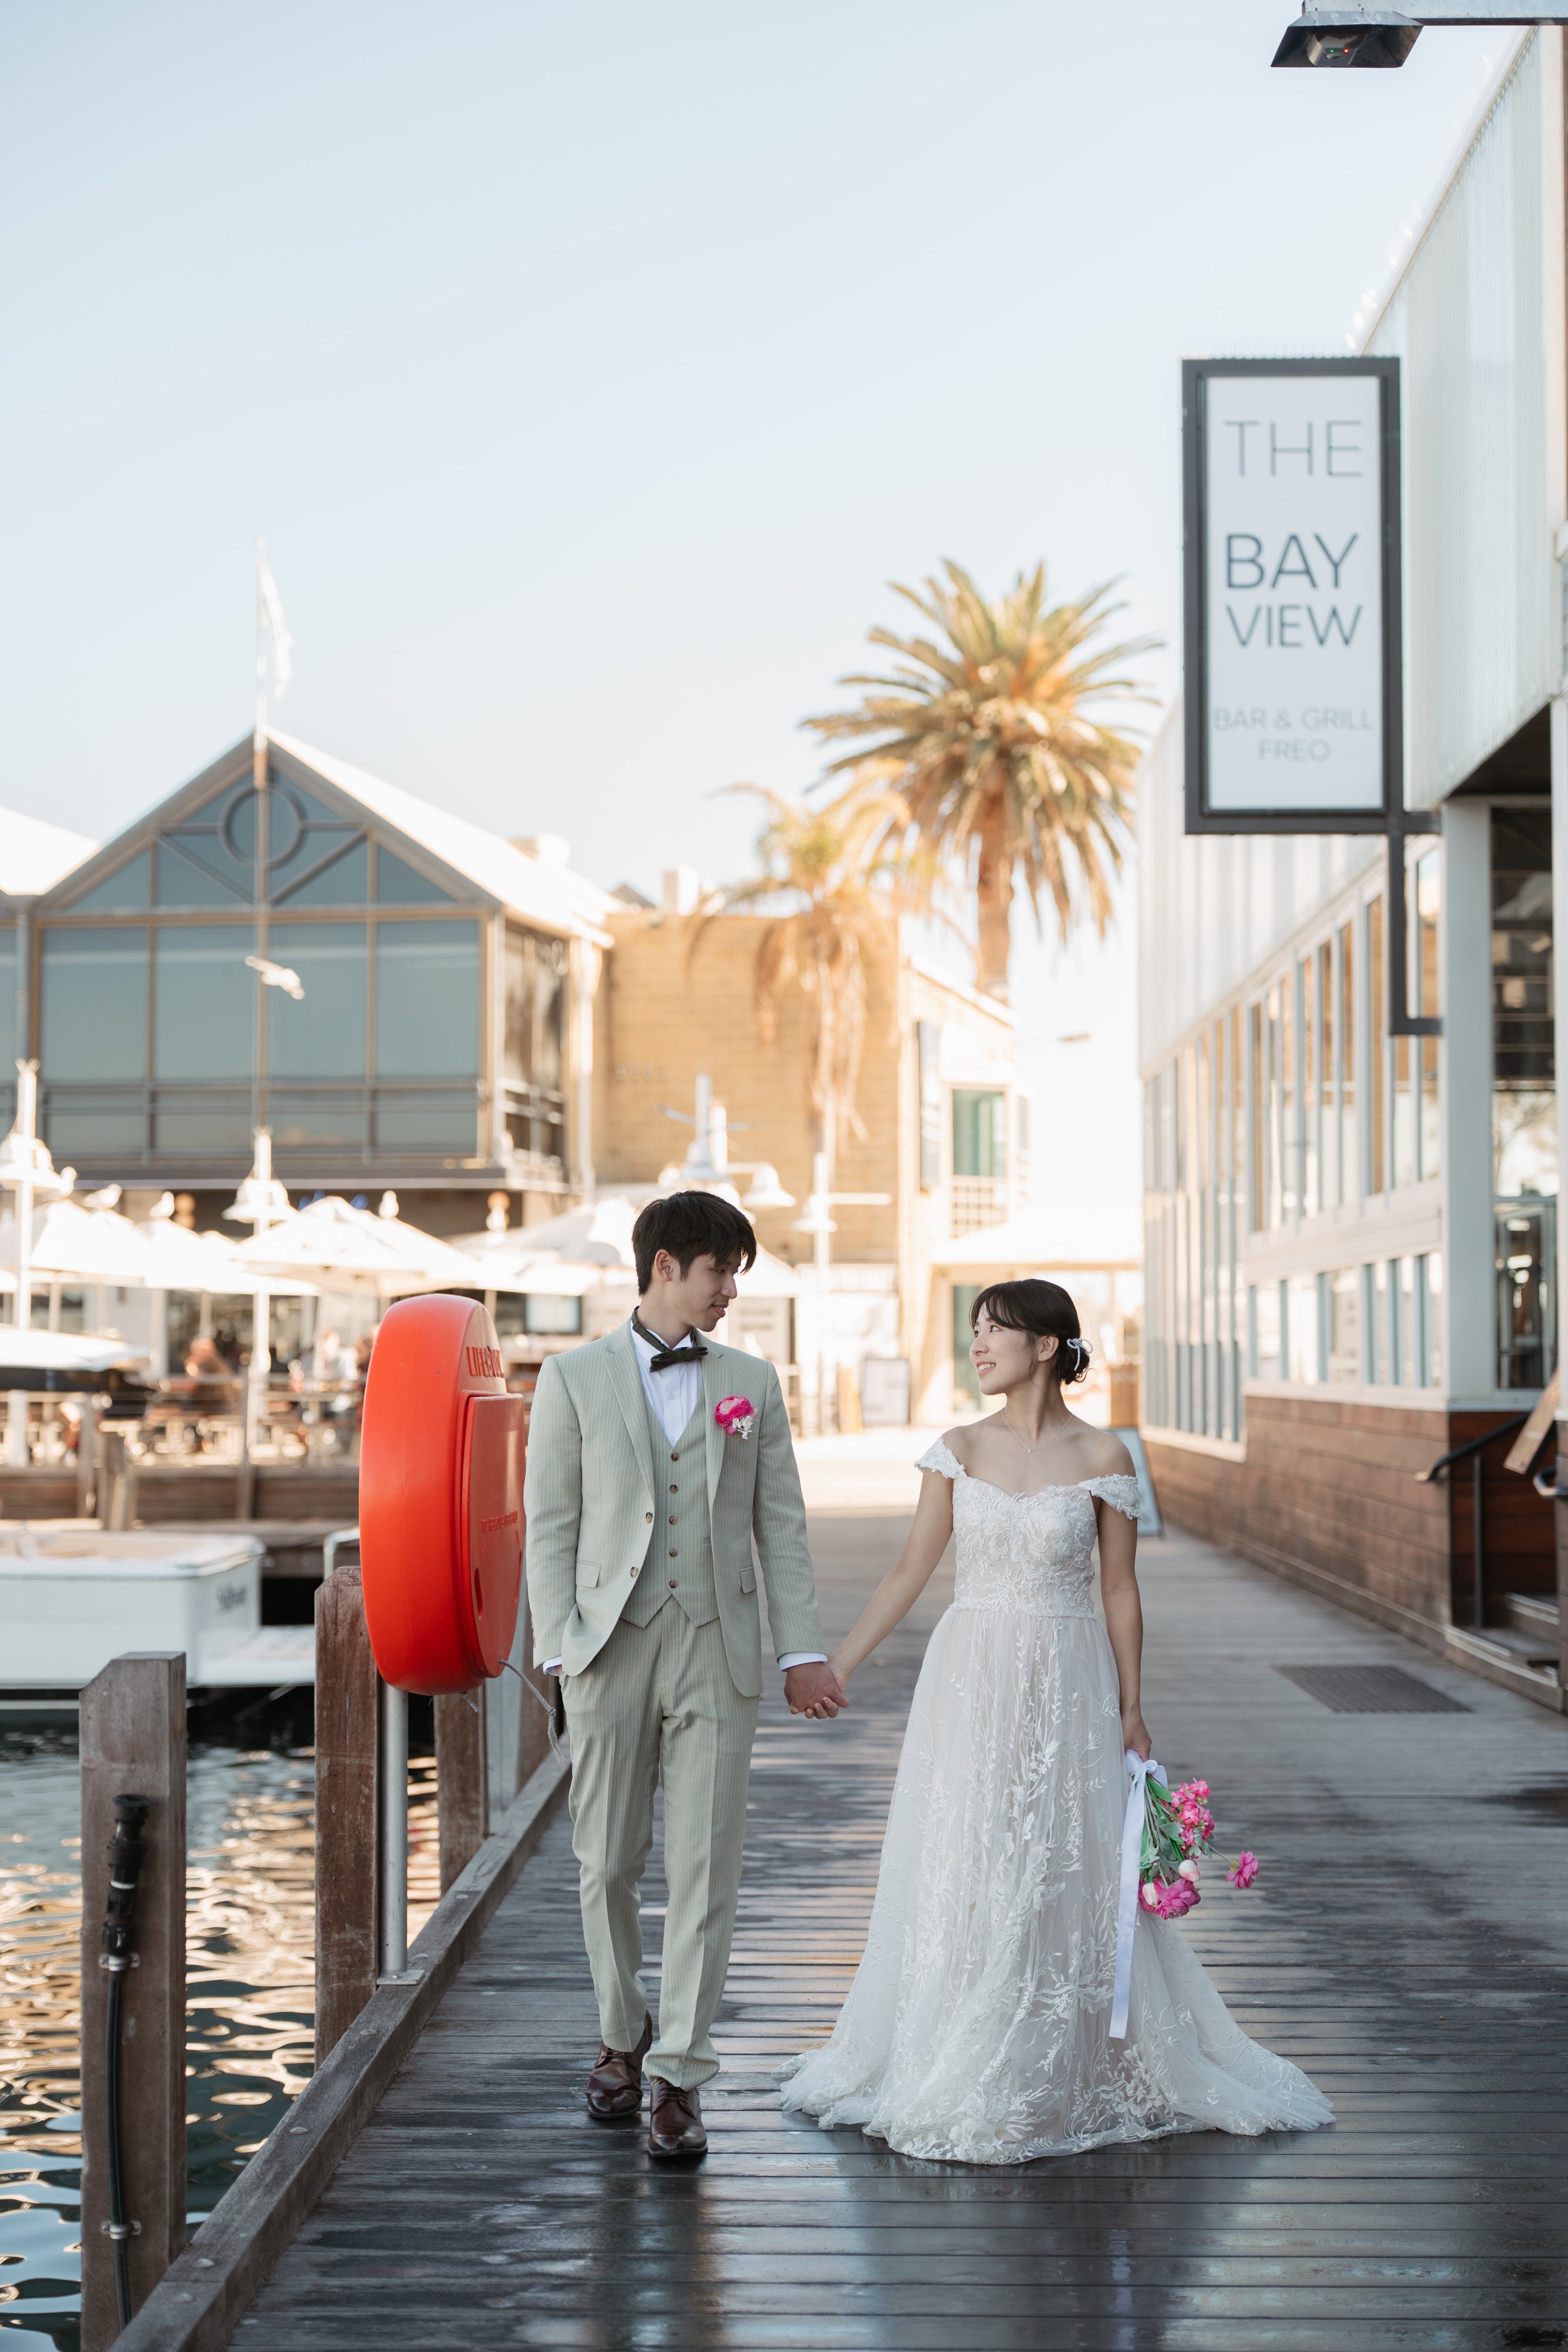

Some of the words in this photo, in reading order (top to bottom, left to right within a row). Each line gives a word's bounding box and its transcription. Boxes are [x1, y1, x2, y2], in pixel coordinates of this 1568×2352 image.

[1223, 419, 1363, 476] THE
[1226, 532, 1359, 589] BAY
[1225, 603, 1363, 647] VIEW
[1213, 707, 1266, 730] BAR
[1275, 707, 1293, 730] &
[1300, 707, 1374, 730] GRILL
[1259, 739, 1331, 761] FREO
